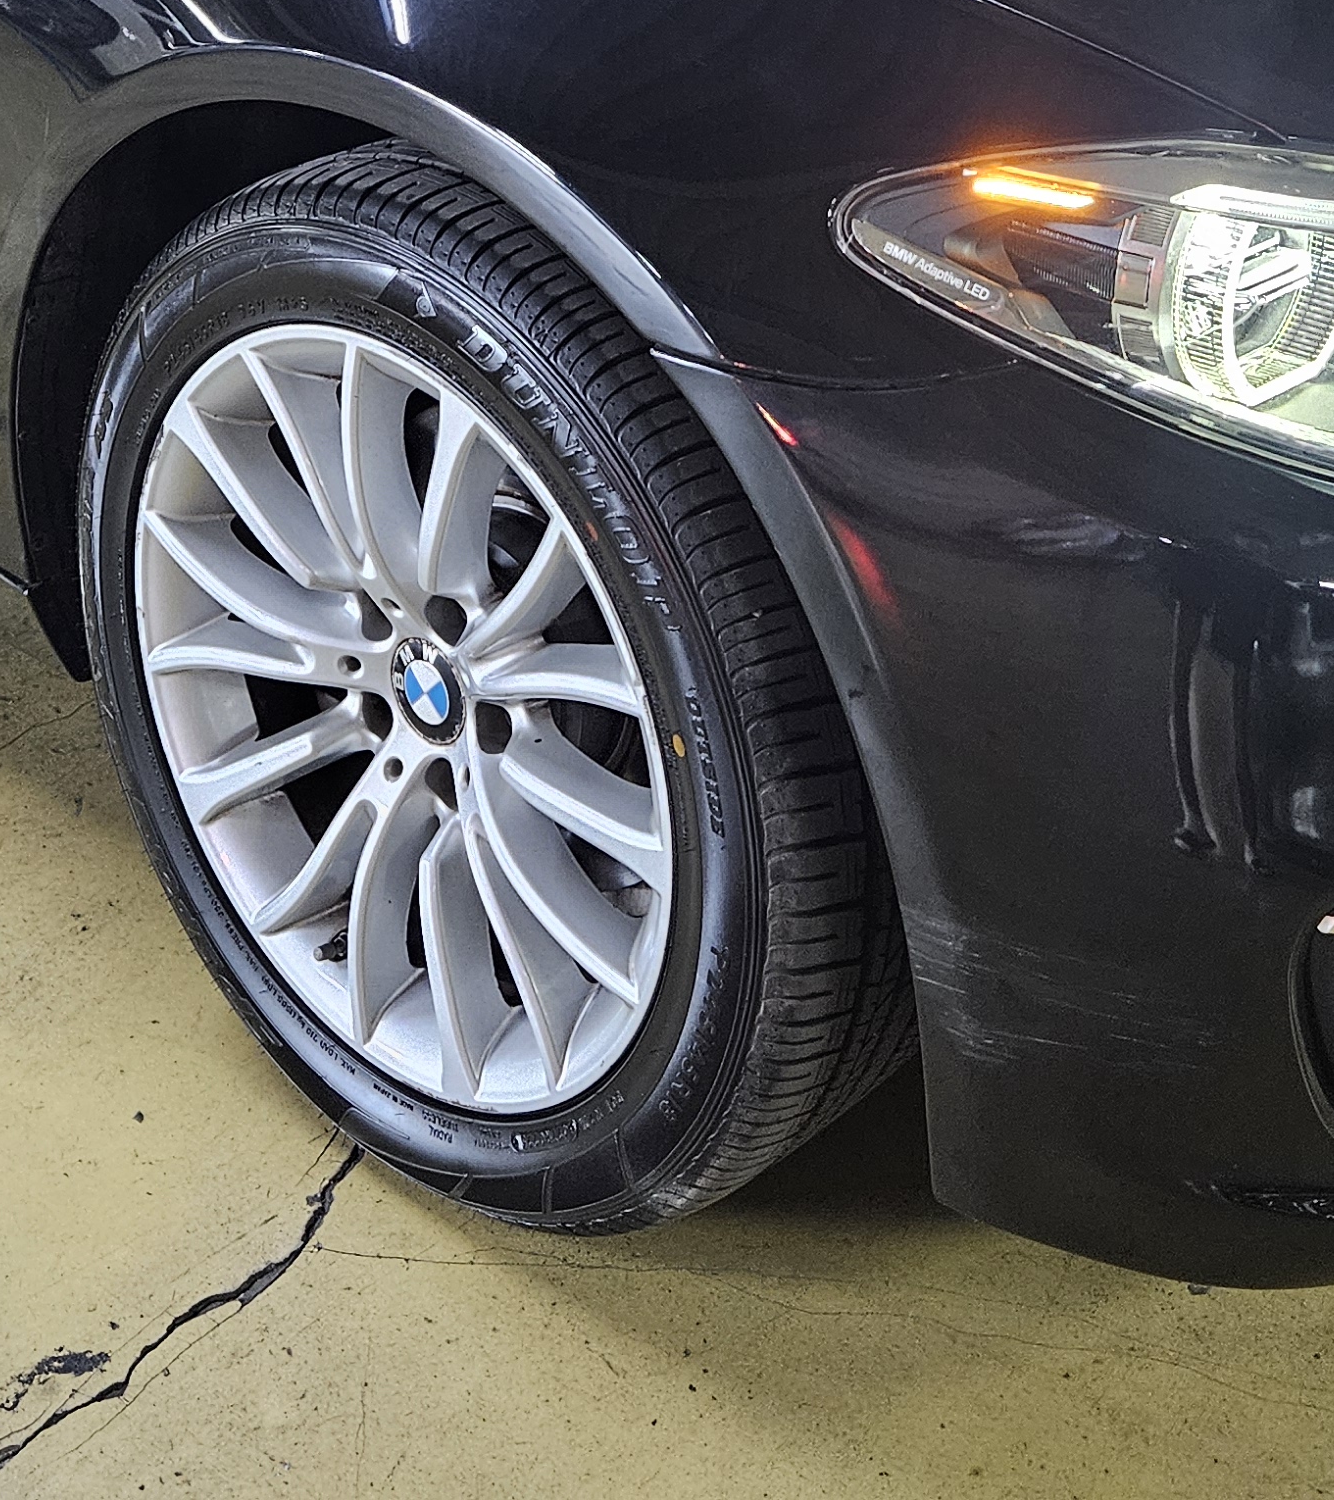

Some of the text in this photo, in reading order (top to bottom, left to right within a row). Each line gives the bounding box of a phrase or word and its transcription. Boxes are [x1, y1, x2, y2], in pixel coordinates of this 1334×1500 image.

[883, 241, 991, 300] BMW Adaptive LED
[457, 324, 681, 632] DUNLOP
[394, 642, 439, 691] BMW
[686, 693, 725, 838] OUTSIDE
